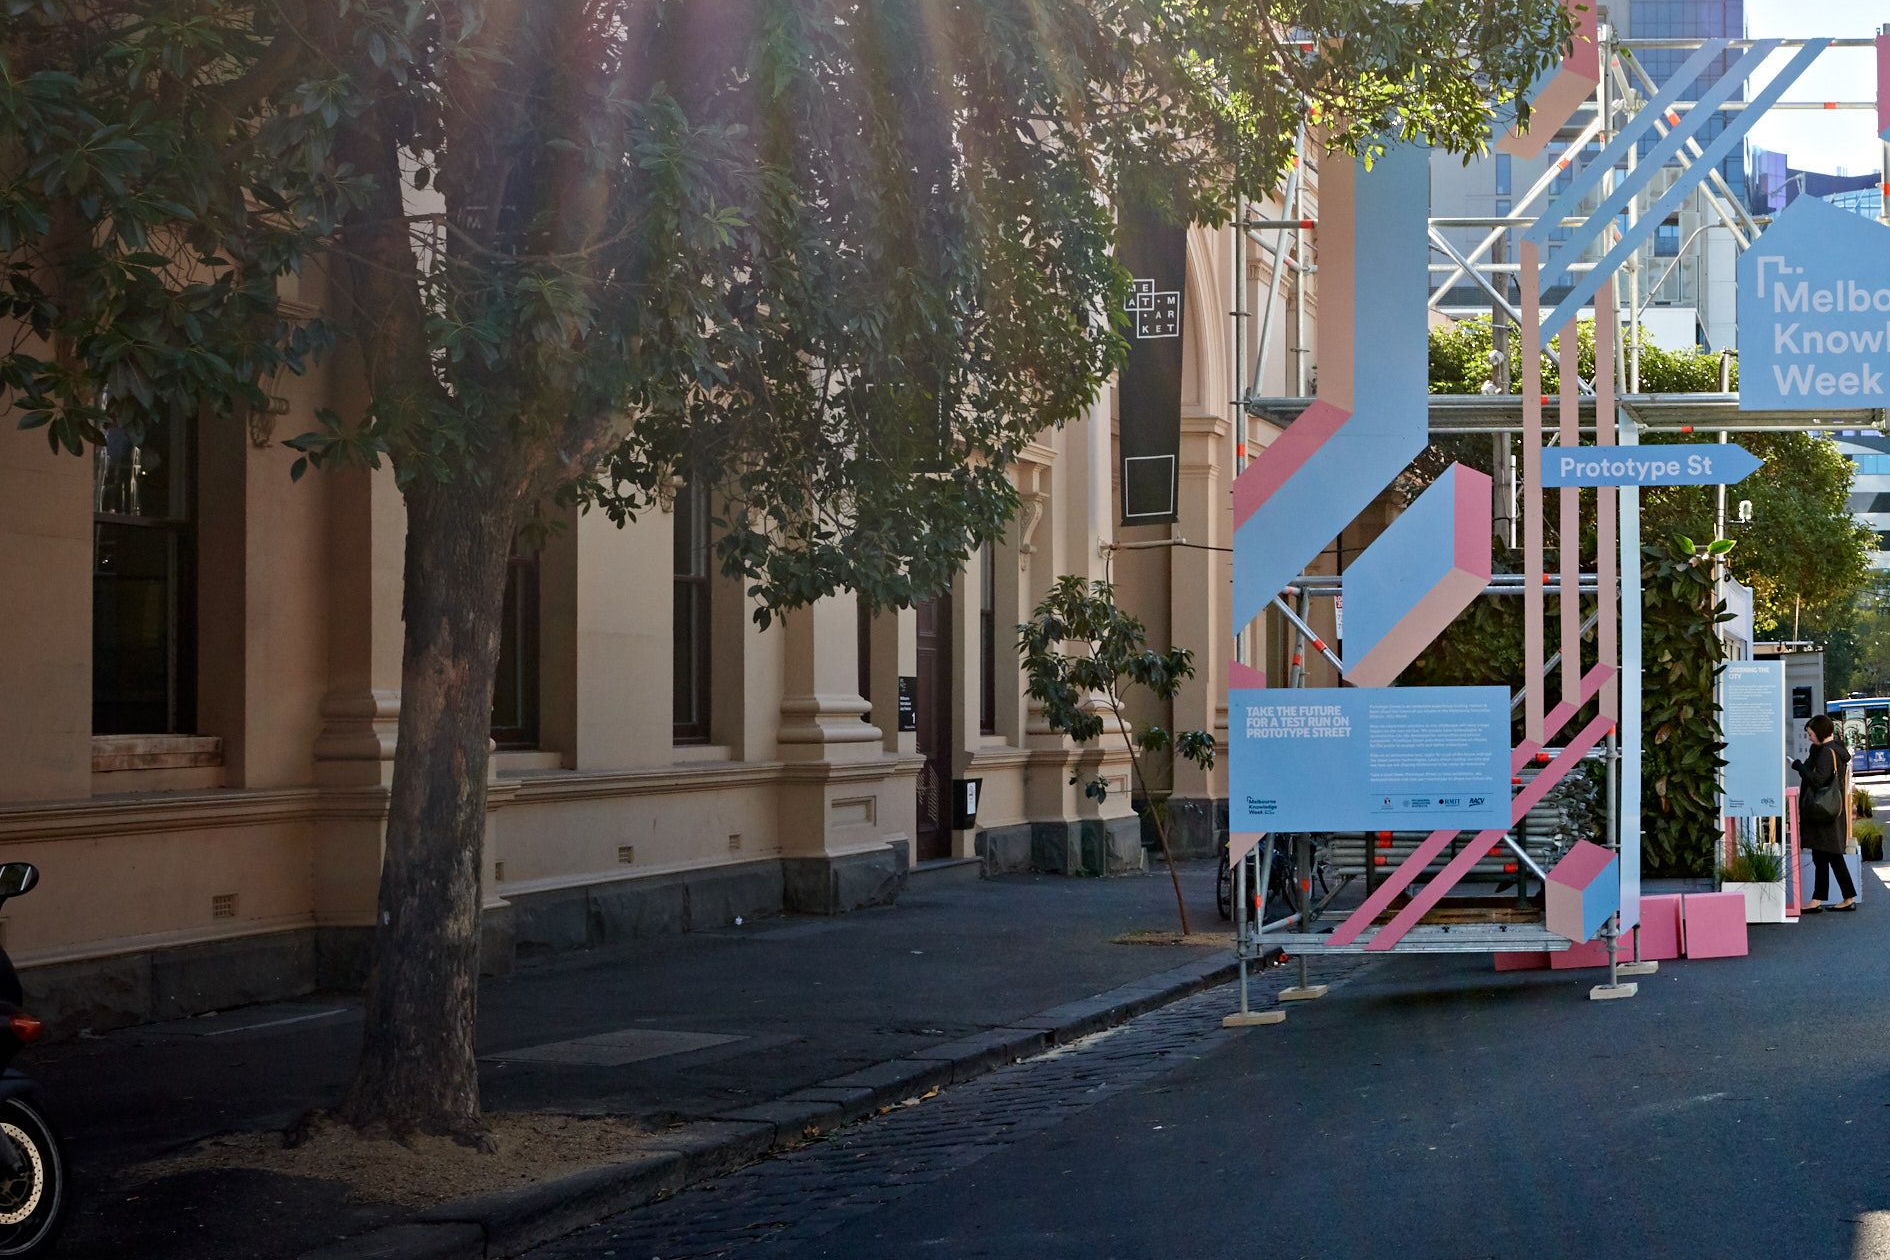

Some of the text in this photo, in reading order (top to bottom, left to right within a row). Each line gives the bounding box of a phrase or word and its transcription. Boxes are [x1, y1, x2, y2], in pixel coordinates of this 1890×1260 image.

[1772, 363, 1884, 396] Week
[1560, 454, 1712, 481] Prototype St
[1246, 705, 1341, 717] TAKE THE FUTURE
[1247, 716, 1349, 727] FOR A TEST RUN ON
[1246, 727, 1352, 738] PROTOTYPE STREET
